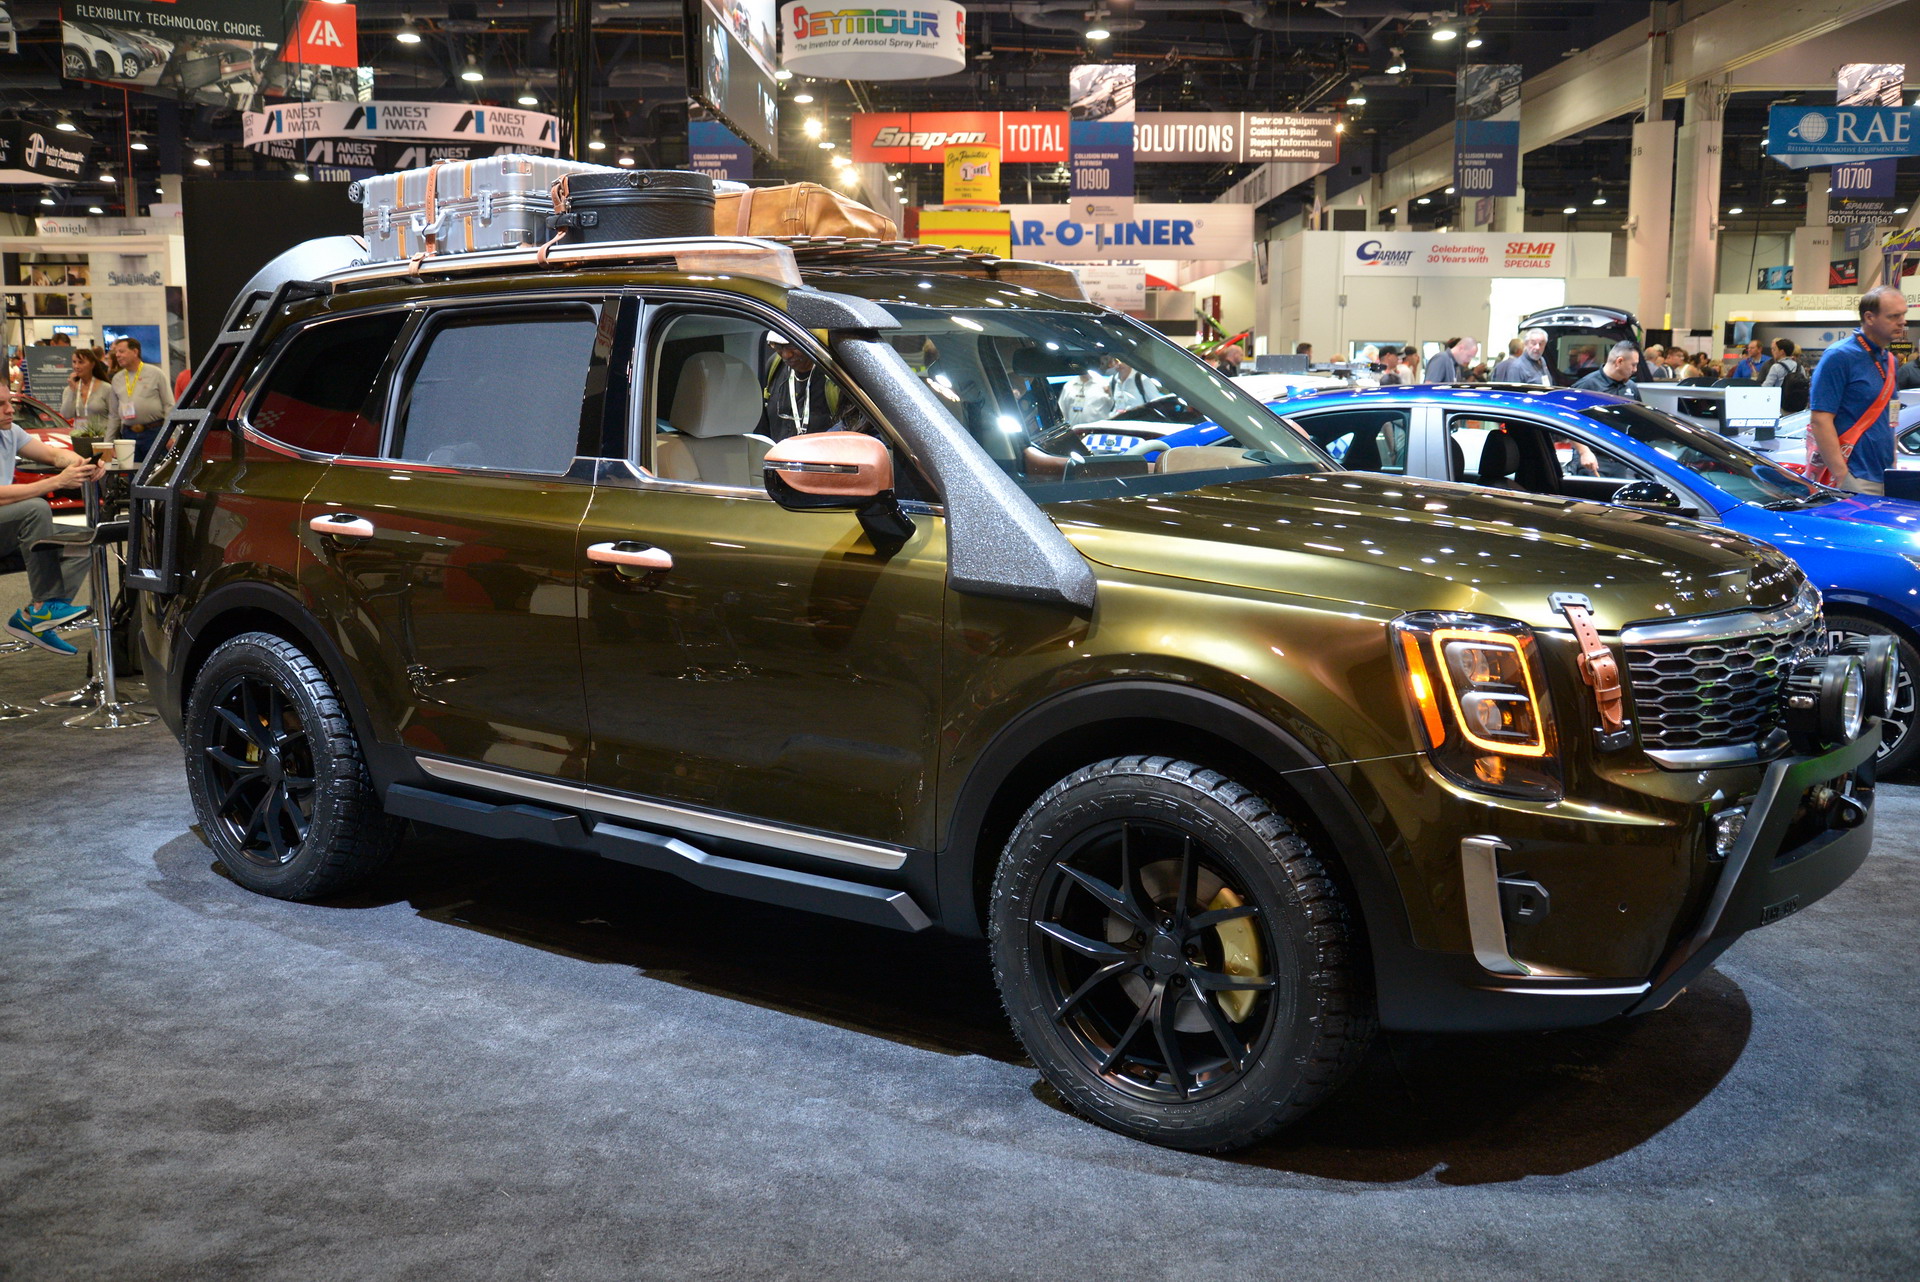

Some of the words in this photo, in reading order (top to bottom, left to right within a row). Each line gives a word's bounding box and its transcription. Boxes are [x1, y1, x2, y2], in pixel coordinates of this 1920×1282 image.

[76, 4, 143, 23] FLEXIBILITY.
[147, 12, 220, 33] TECHNOLOGY.
[223, 21, 265, 37] CHOICE.
[793, 6, 940, 40] SEYMOUR
[809, 39, 839, 49] Inventor
[841, 38, 851, 46] of
[853, 38, 887, 46] Aerosol
[889, 39, 914, 49] Spray
[286, 106, 323, 120] ANEST
[382, 105, 431, 118] ANEST
[489, 111, 527, 126] ANEST
[288, 120, 321, 133] IWATA
[385, 118, 428, 132] IWATA
[1285, 117, 1332, 127] Equipment
[1835, 112, 1911, 143] RAE
[491, 124, 525, 138] IWATA
[1250, 127, 1288, 137] Collision
[1290, 128, 1318, 138] Repair
[872, 127, 987, 150] Snap-on
[1007, 125, 1064, 152] TOTAL
[1250, 138, 1278, 148] Repair
[1280, 139, 1333, 149] Information
[336, 141, 378, 156] ANEST
[429, 146, 471, 159] ANEST
[1250, 149, 1272, 158] Parts
[1274, 149, 1320, 160] Marketing
[338, 153, 375, 167] IWATA
[1075, 168, 1110, 190] 10900
[1459, 168, 1494, 190] 10800
[1837, 167, 1872, 189] 10700
[1828, 215, 1859, 224] BOOTH
[1860, 215, 1894, 224] #10647
[1356, 240, 1415, 261] GARMAT
[1431, 244, 1486, 255] Celebrating
[1505, 242, 1556, 254] SEMA
[1426, 254, 1440, 264] 30
[1441, 254, 1467, 264] Years
[1468, 254, 1489, 264] with
[1504, 259, 1552, 269] SPECIALS
[1846, 295, 1860, 307] 36
